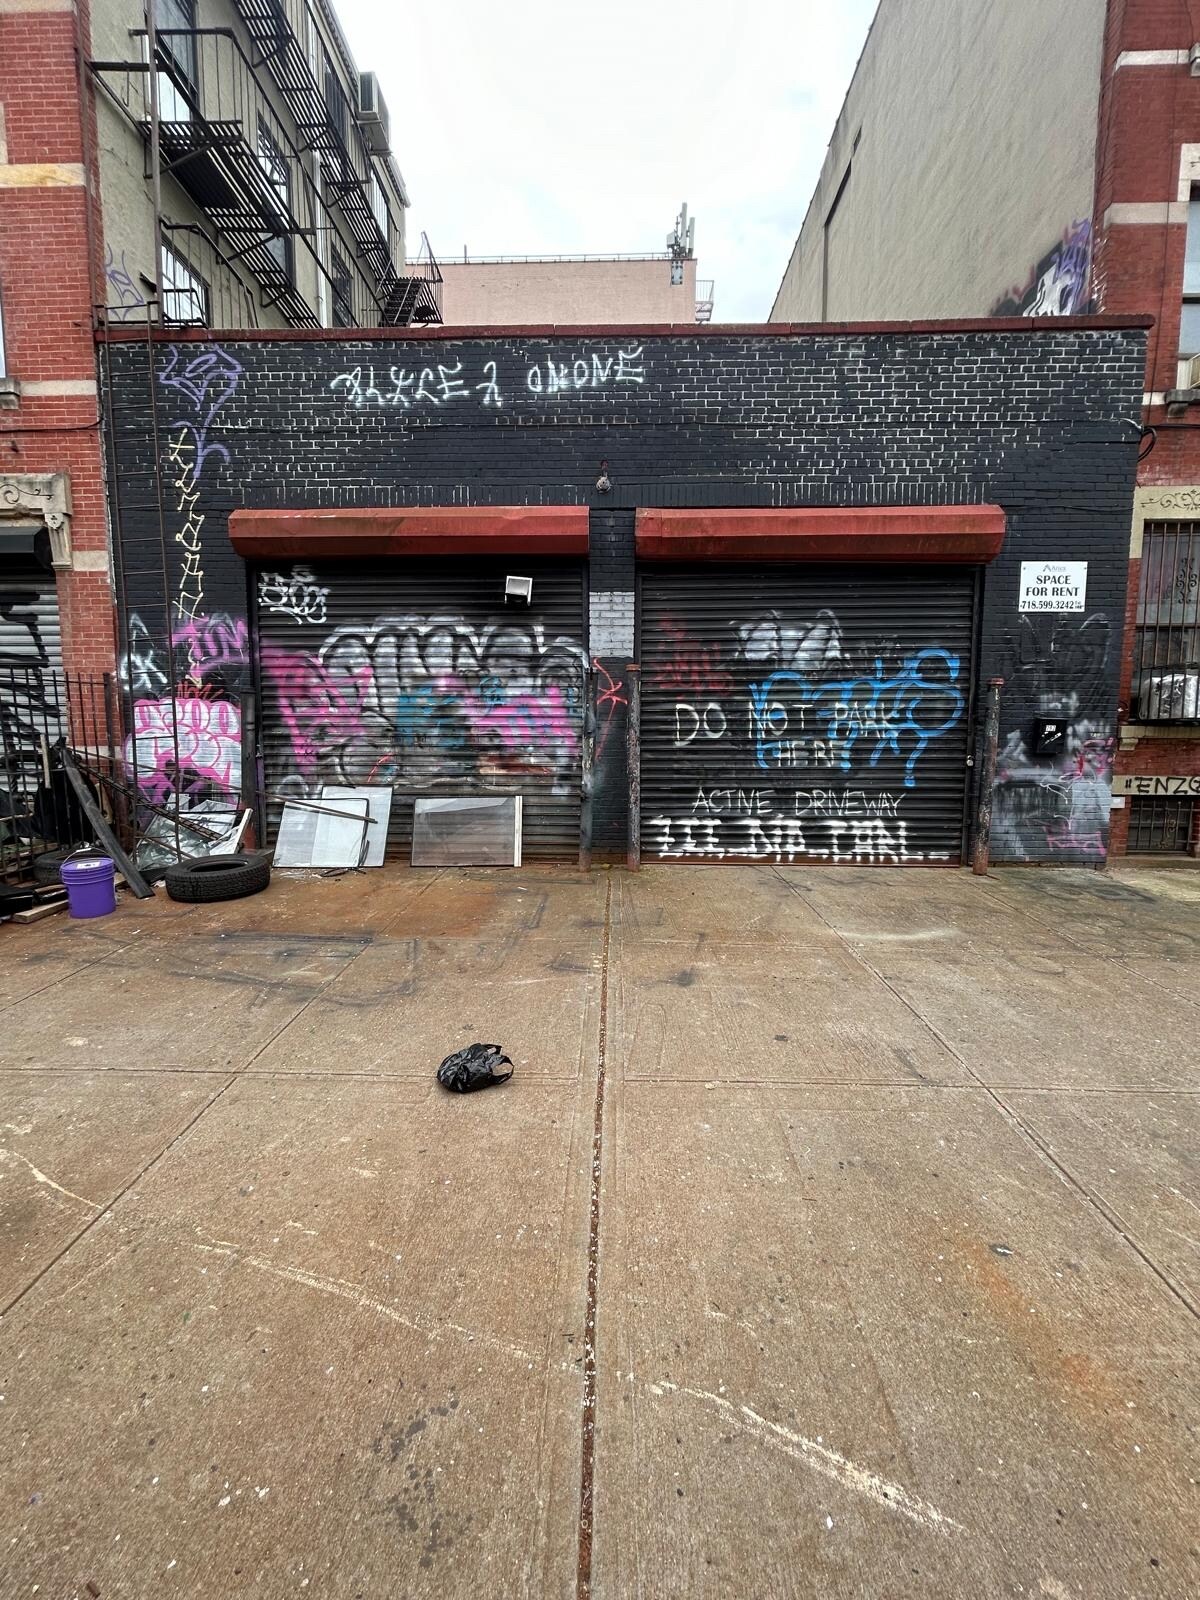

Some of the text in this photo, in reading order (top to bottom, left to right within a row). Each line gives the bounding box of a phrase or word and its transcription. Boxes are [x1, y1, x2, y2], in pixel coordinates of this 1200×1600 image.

[1035, 574, 1072, 585] SPACE
[1025, 586, 1081, 597] FOR RENT
[1021, 600, 1075, 610] 718.599.3242
[674, 701, 728, 747] DO
[748, 700, 814, 739] NOT
[777, 741, 850, 768] HERE
[691, 787, 907, 817] ACTIVE DRIVEWAY
